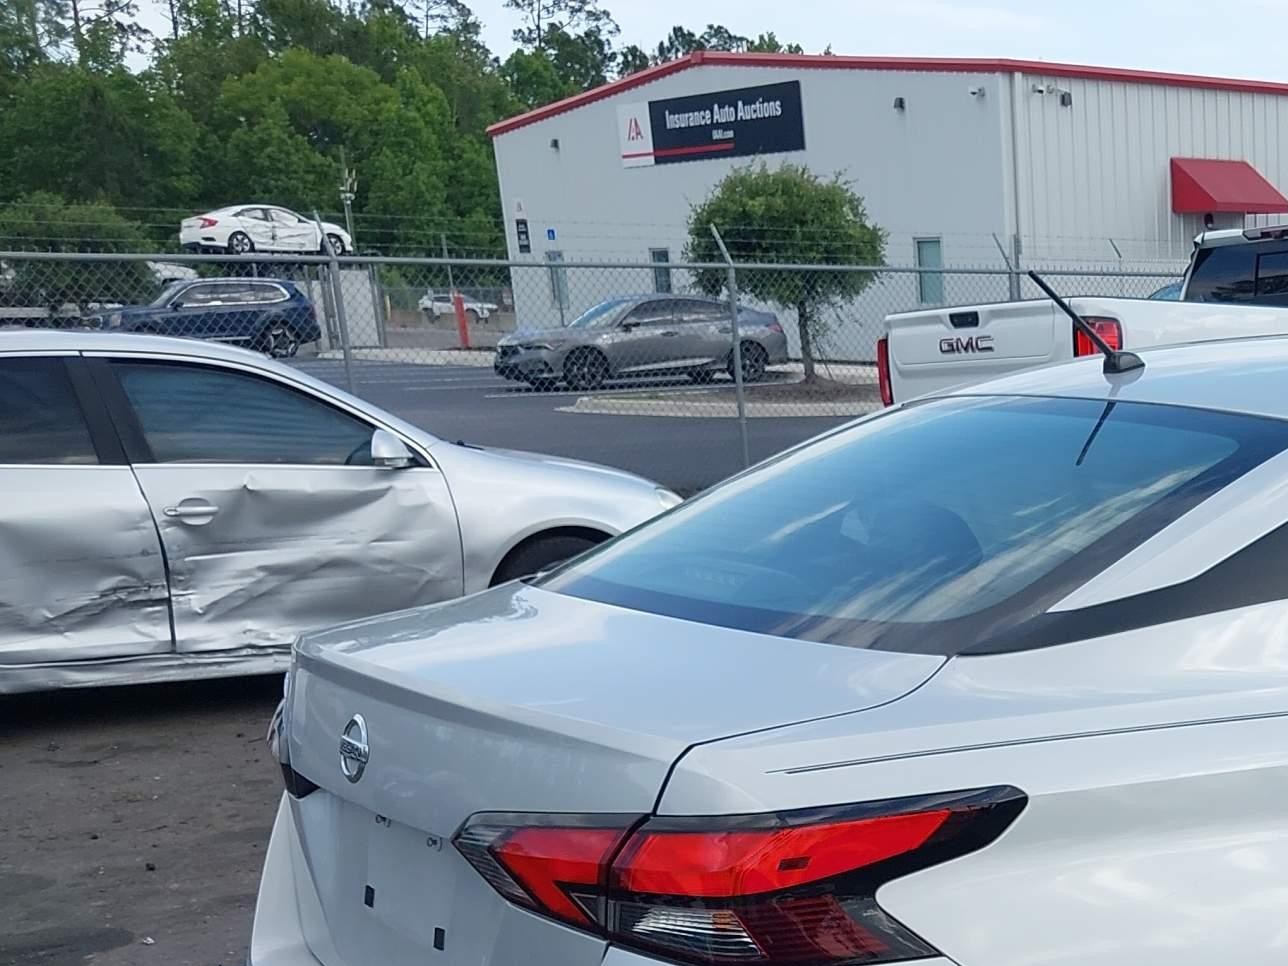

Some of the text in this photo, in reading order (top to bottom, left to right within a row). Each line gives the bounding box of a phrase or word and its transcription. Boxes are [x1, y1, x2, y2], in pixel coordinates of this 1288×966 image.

[664, 98, 782, 130] Insurance Auto Auctions
[939, 335, 994, 354] GMC
